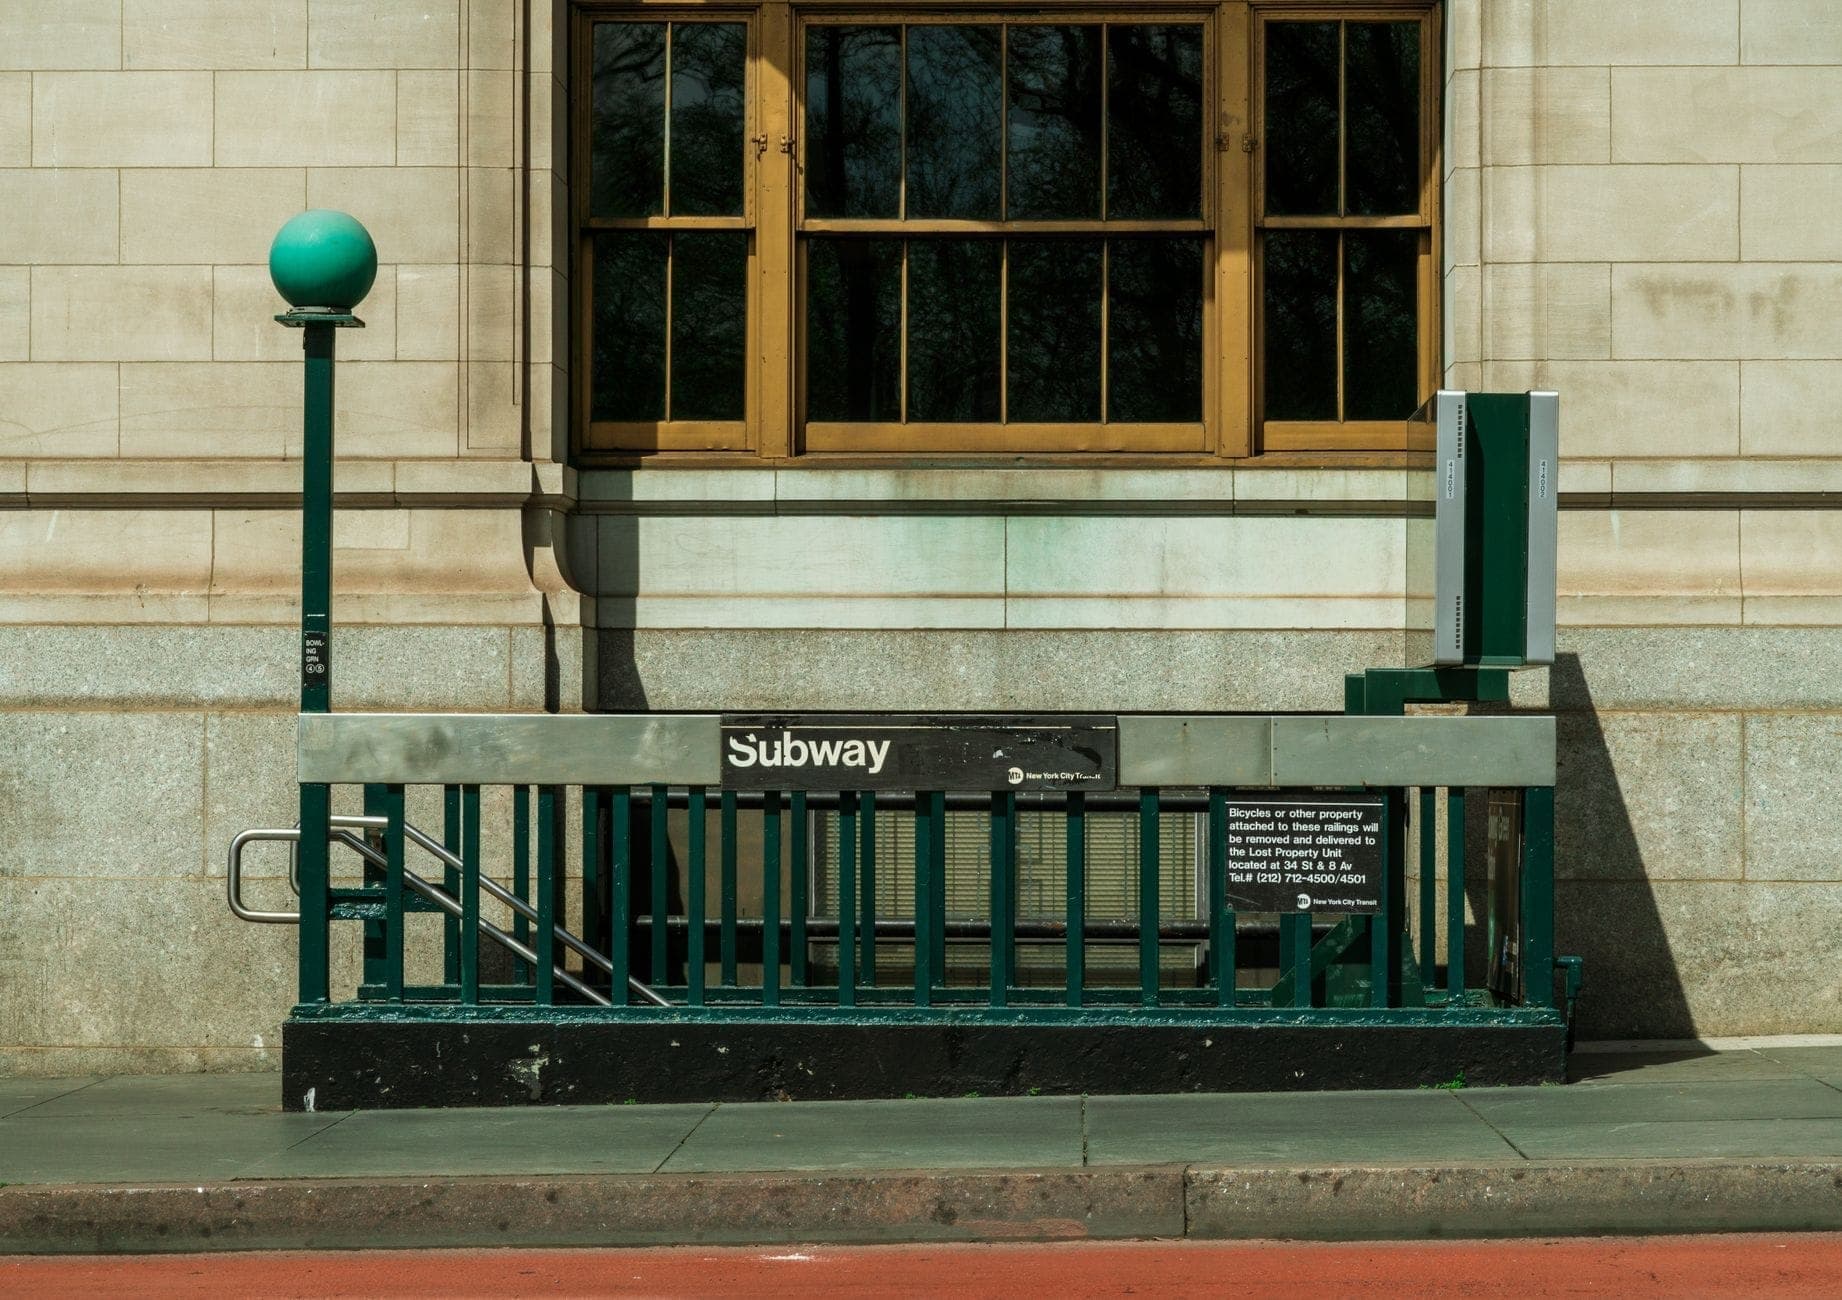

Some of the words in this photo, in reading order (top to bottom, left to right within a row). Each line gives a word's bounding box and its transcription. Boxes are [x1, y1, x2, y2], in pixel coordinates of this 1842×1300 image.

[728, 731, 891, 774] Subway
[1060, 772, 1075, 781] City
[1229, 808, 1271, 819] Bicycles
[1275, 810, 1286, 818] or
[1289, 809, 1316, 818] other
[1320, 810, 1363, 820] property
[1229, 821, 1274, 831] attached
[1278, 822, 1288, 831] to
[1292, 822, 1320, 831] these
[1324, 822, 1359, 834] railings
[1362, 822, 1379, 832] will
[1229, 834, 1242, 843] be
[1246, 834, 1290, 844] removed
[1293, 835, 1312, 844] and
[1315, 835, 1361, 845] delivered
[1365, 836, 1376, 845] to
[1229, 847, 1245, 856] the
[1249, 847, 1272, 857] Lost
[1275, 848, 1318, 859] Property
[1322, 848, 1342, 857] Unit
[1228, 860, 1267, 870] located
[1270, 861, 1281, 870] at
[1284, 860, 1297, 870] 34
[1301, 861, 1313, 870] St
[1317, 861, 1325, 871] &
[1328, 861, 1336, 870] 8
[1340, 861, 1352, 871] Av
[1229, 872, 1253, 882] Tel.#
[1256, 872, 1281, 884] (212)
[1284, 873, 1366, 884] 712-4500/4501
[1342, 898, 1355, 906] City
